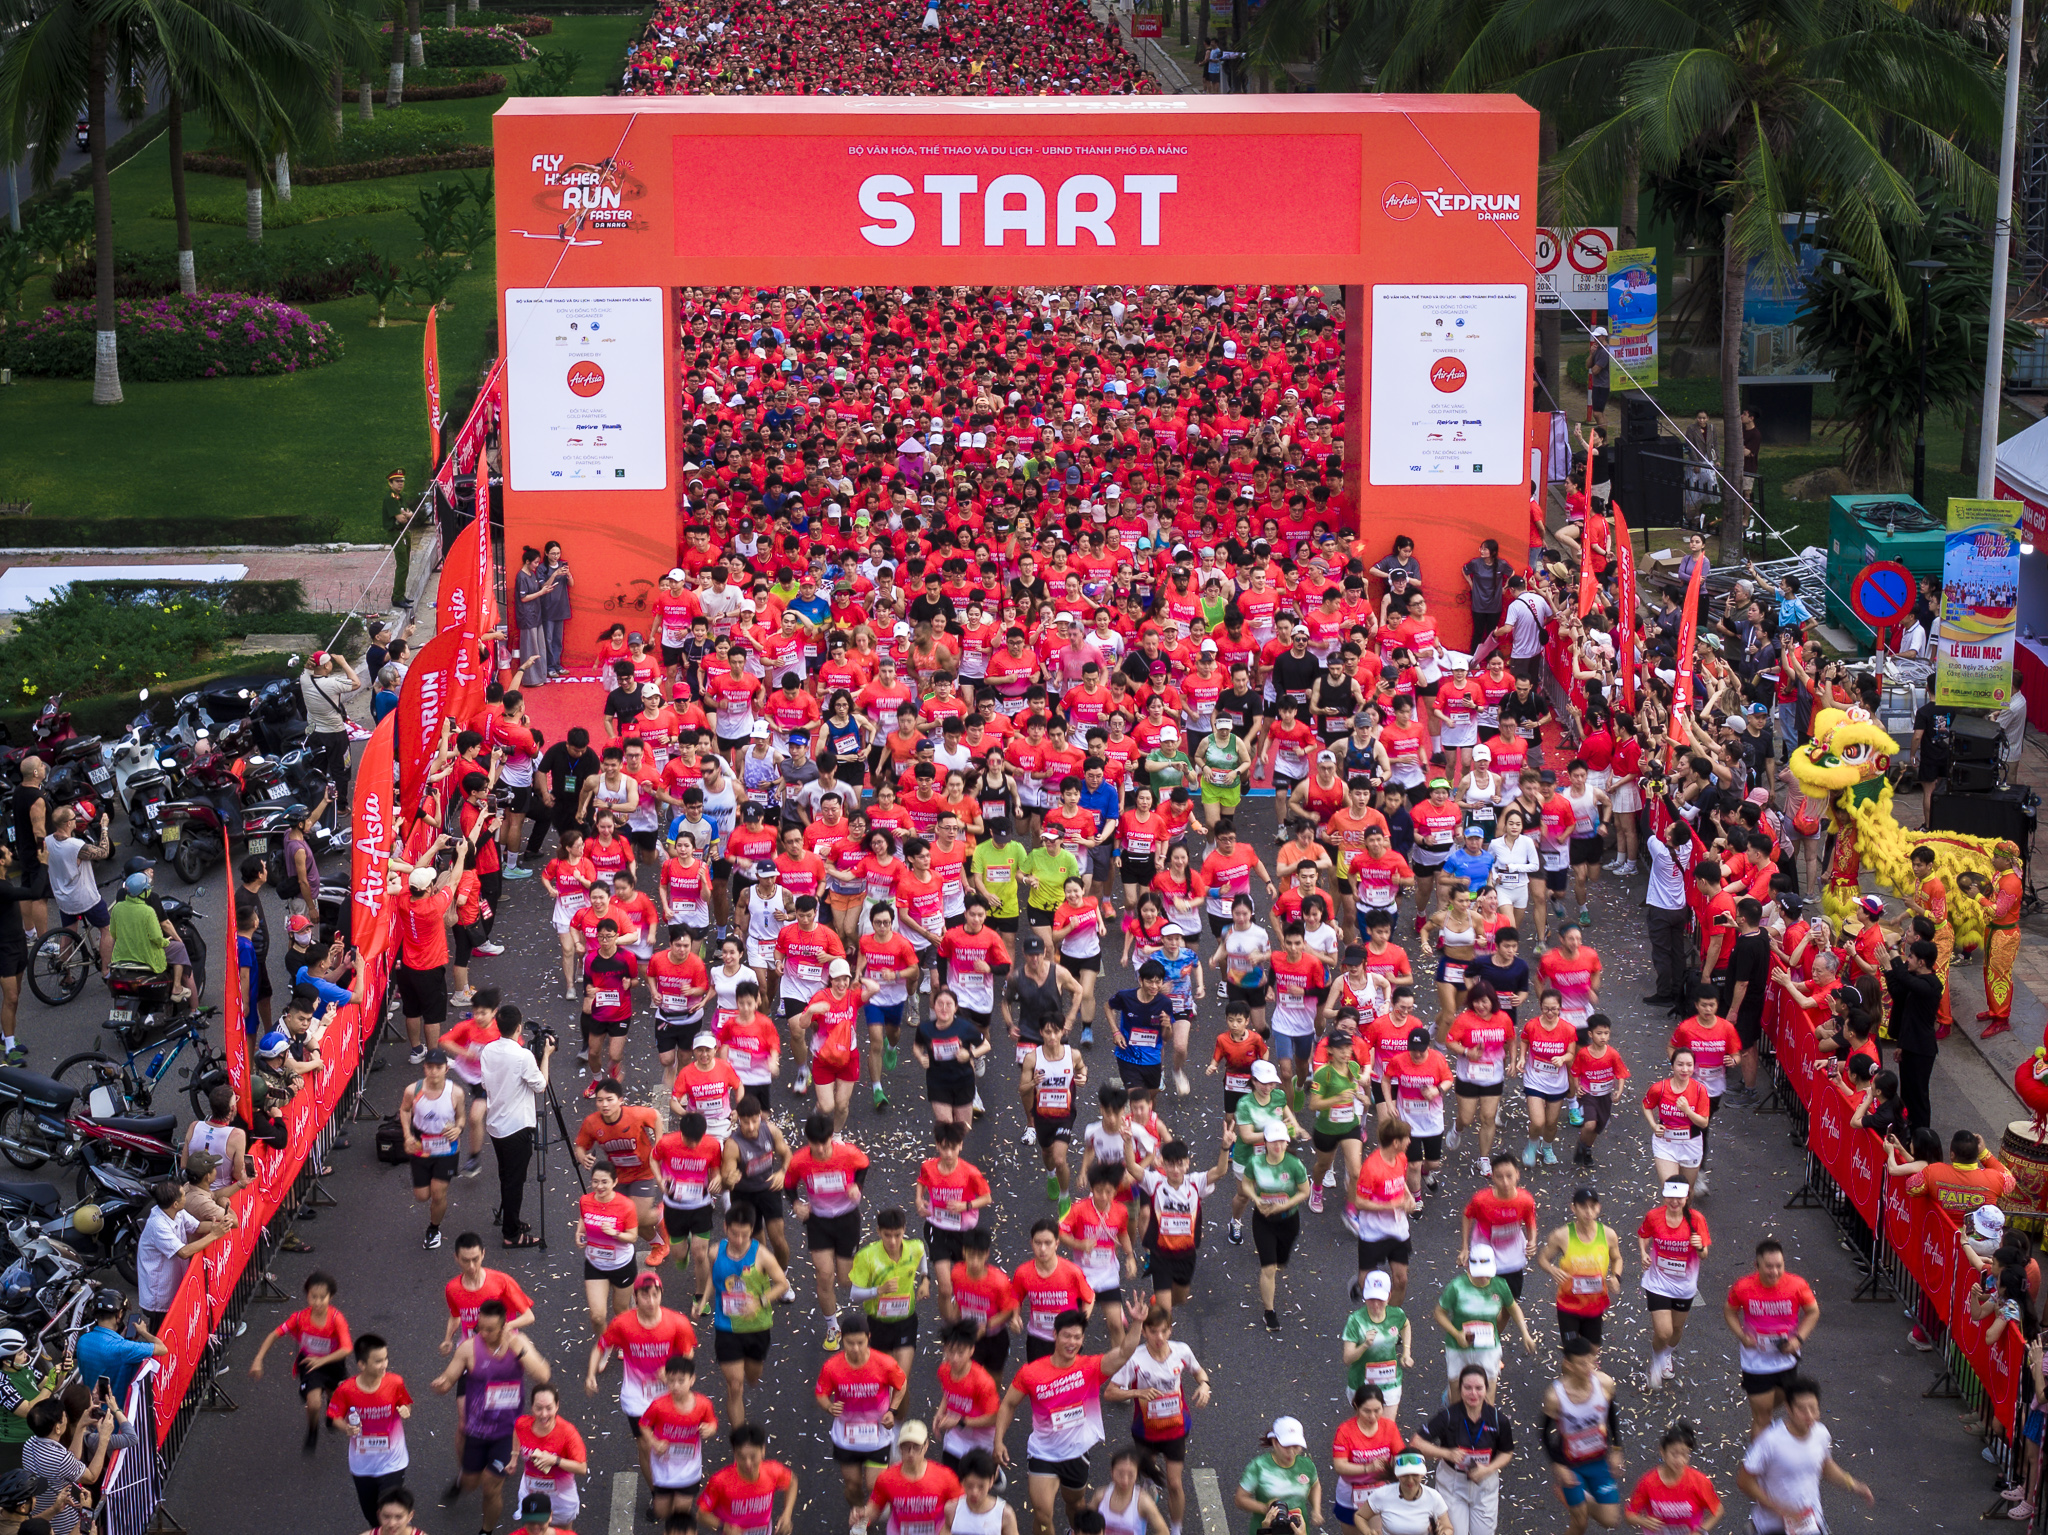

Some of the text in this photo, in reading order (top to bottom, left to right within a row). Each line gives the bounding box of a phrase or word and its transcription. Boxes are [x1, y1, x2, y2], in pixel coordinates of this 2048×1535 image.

[849, 145, 864, 156] BỘ
[866, 145, 890, 155] VĂN
[892, 144, 917, 156] HÓA,
[920, 144, 940, 155] THẾ
[942, 146, 972, 155] THAO
[974, 144, 989, 155] VÀ
[992, 146, 1006, 155] DU
[1010, 146, 1032, 157] LỊCH
[1042, 146, 1073, 155] UBND
[1075, 144, 1112, 155] THÀNH
[1114, 144, 1137, 155] PHỐ
[1139, 144, 1154, 155] ĐÀ
[532, 155, 563, 171] FLY
[563, 186, 620, 209] RUN
[1421, 187, 1520, 216] REDRUN
[590, 210, 632, 220] FASTER
[858, 174, 1178, 246] START
[1478, 212, 1519, 220] DA NANG
[1536, 241, 1549, 258] 0
[2034, 510, 2046, 531] GIỜ
[1951, 641, 2002, 662] LỄ KHAI MẠC
[354, 792, 390, 918] AirAsia
[1822, 1108, 1840, 1140] AirAsia
[1853, 1148, 1871, 1180] AirAsia
[1889, 1188, 1910, 1223] AirAsia
[1938, 1189, 1986, 1205] FAIFO
[1924, 1233, 1944, 1266] AirAsia
